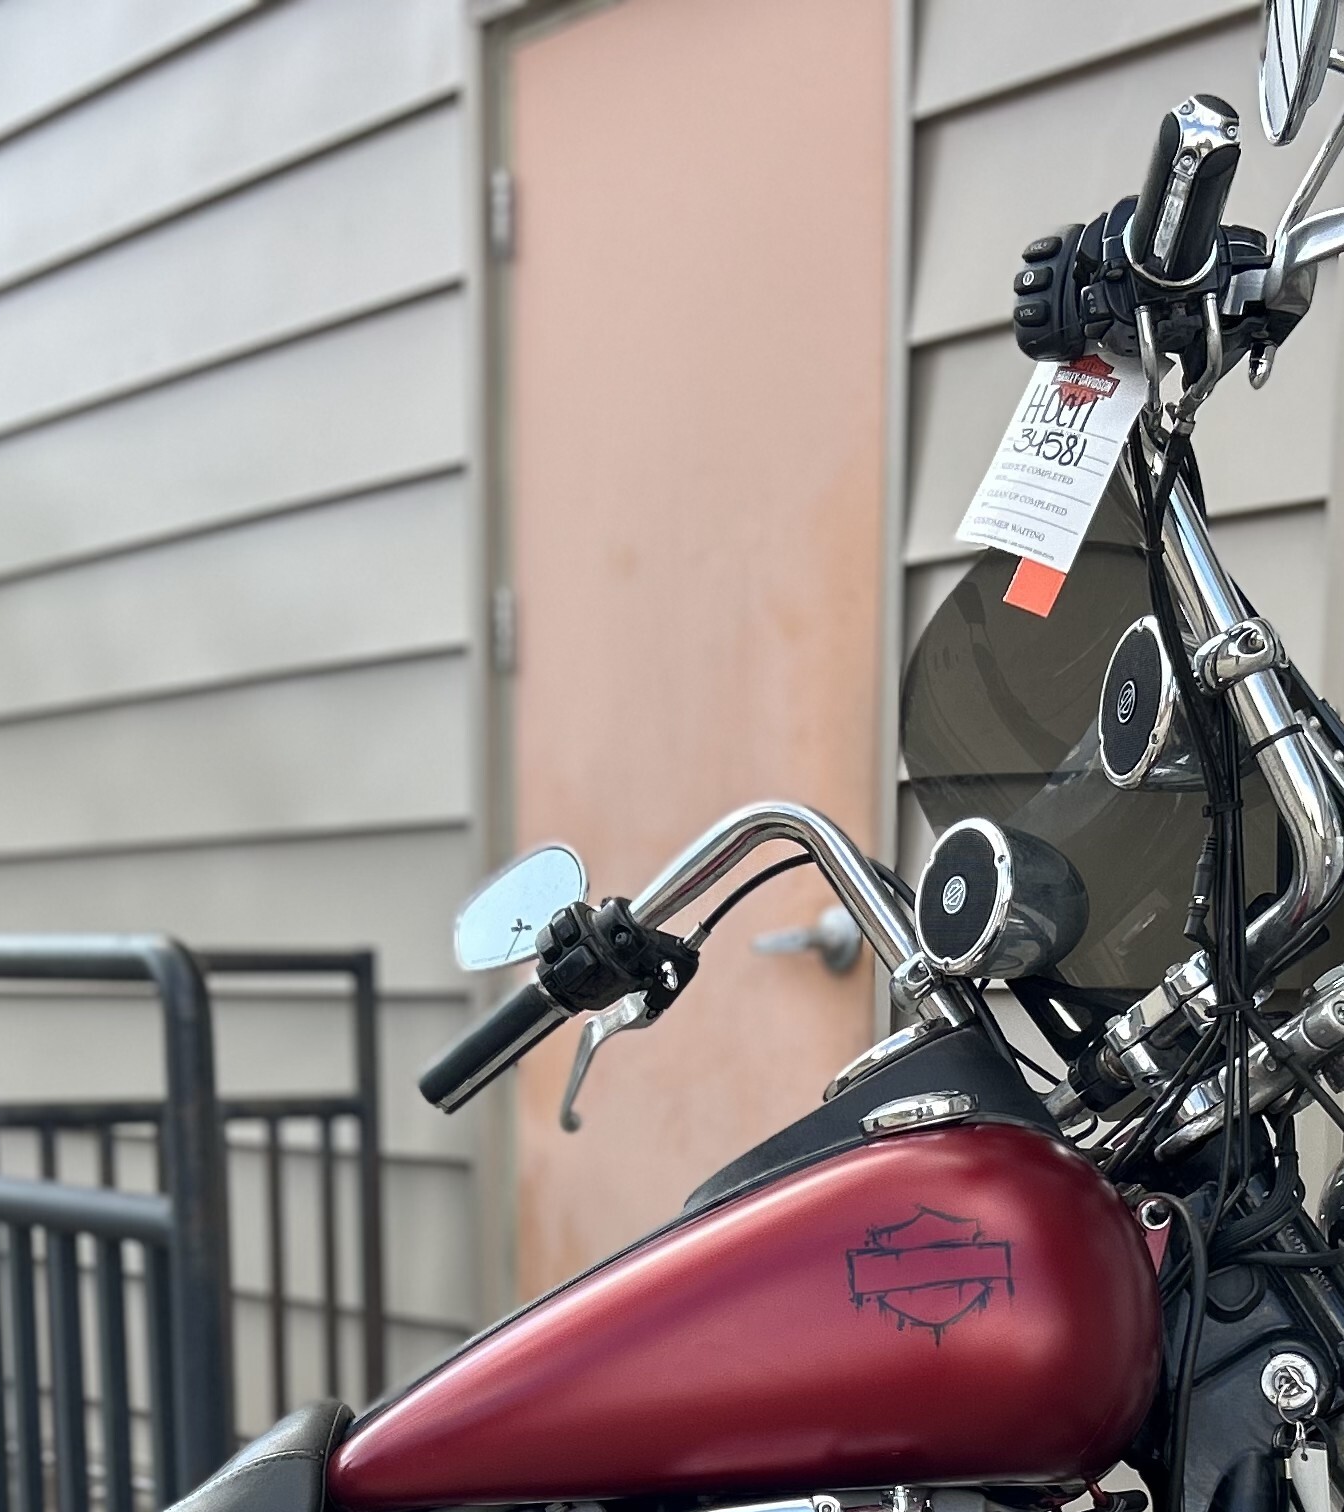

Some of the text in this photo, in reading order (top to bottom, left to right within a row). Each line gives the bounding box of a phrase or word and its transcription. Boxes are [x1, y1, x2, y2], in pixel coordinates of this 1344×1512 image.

[1013, 428, 1087, 467] 34581
[1019, 494, 1068, 516] COMPLETED
[1011, 524, 1046, 542] WAITING
